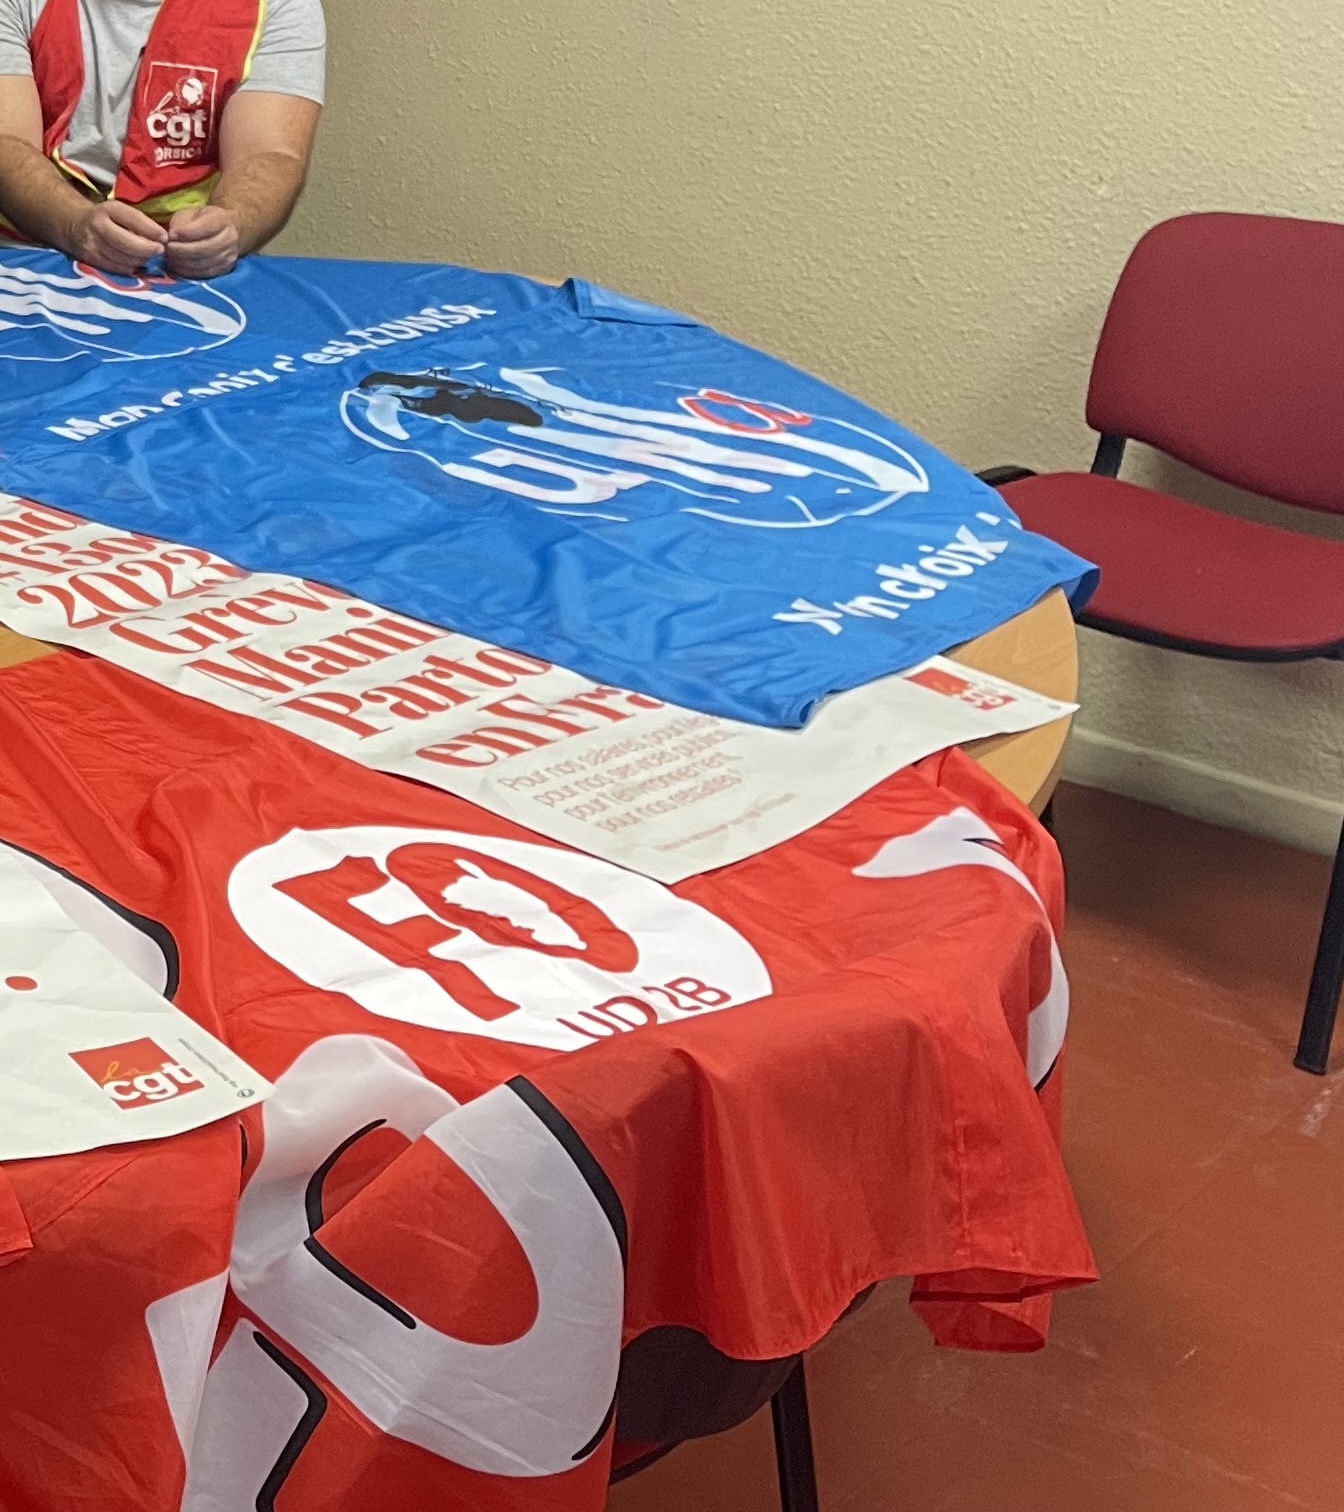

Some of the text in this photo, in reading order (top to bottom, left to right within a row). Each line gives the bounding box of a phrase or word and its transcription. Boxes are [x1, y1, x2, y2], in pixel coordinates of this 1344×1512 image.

[146, 108, 208, 147] cgt
[415, 721, 558, 769] en
[271, 841, 640, 1023] FO
[102, 1061, 201, 1102] cgt
